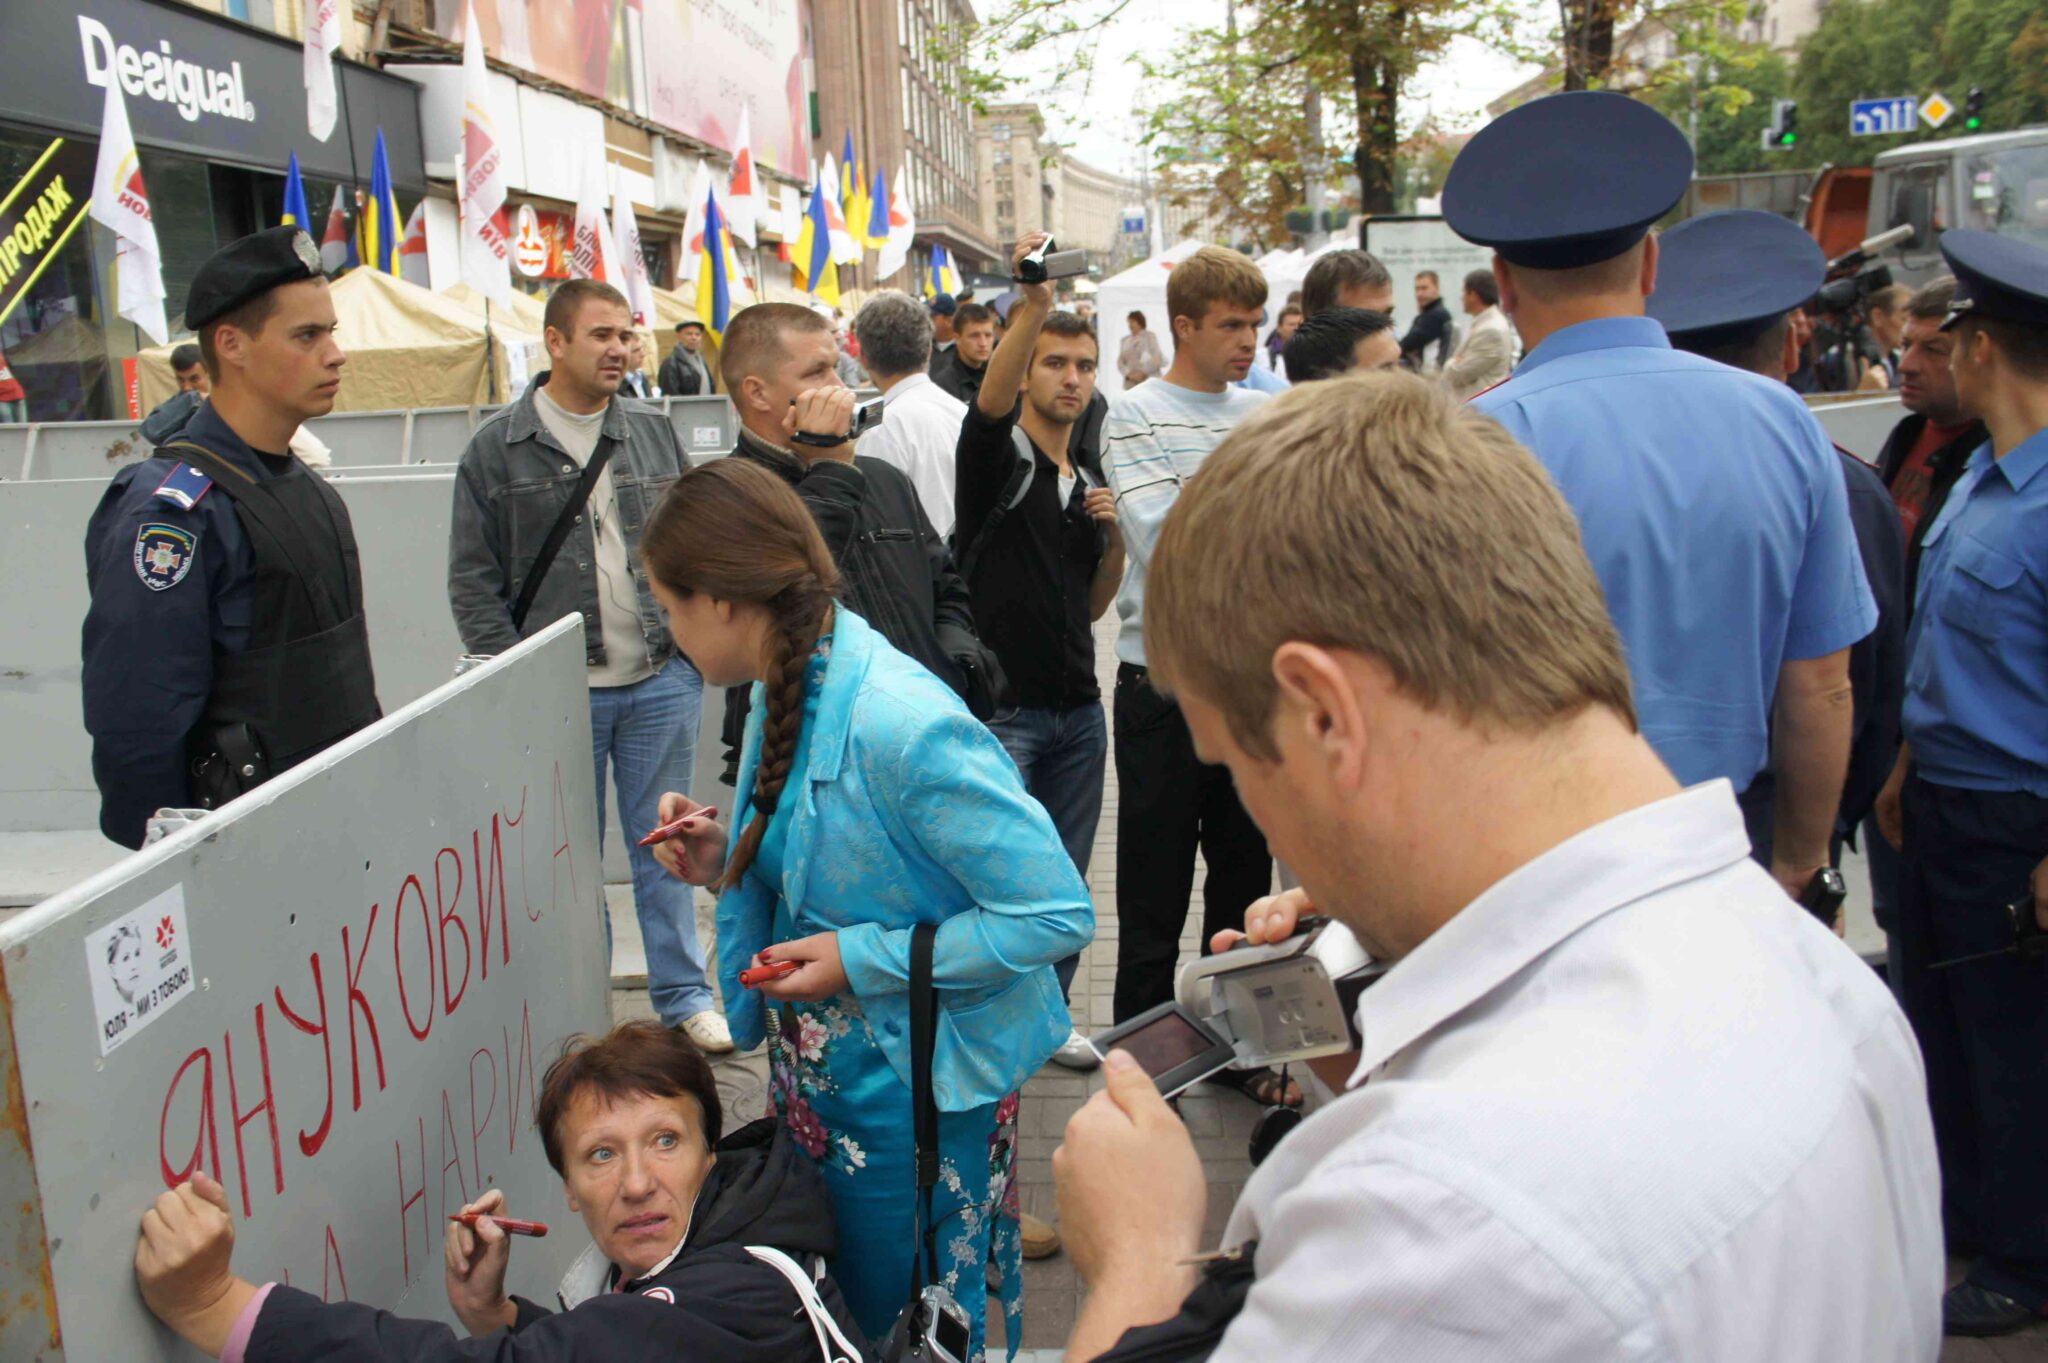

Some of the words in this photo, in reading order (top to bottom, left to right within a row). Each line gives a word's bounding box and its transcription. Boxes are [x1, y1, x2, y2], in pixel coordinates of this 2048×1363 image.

[0, 174, 73, 294] ПРОДАЖ
[576, 225, 602, 256] БЛО
[103, 1011, 128, 1041] ЮЛЯ
[136, 993, 152, 1019] МИ
[152, 989, 158, 1008] З
[158, 964, 191, 1001] ТОБОЮ!
